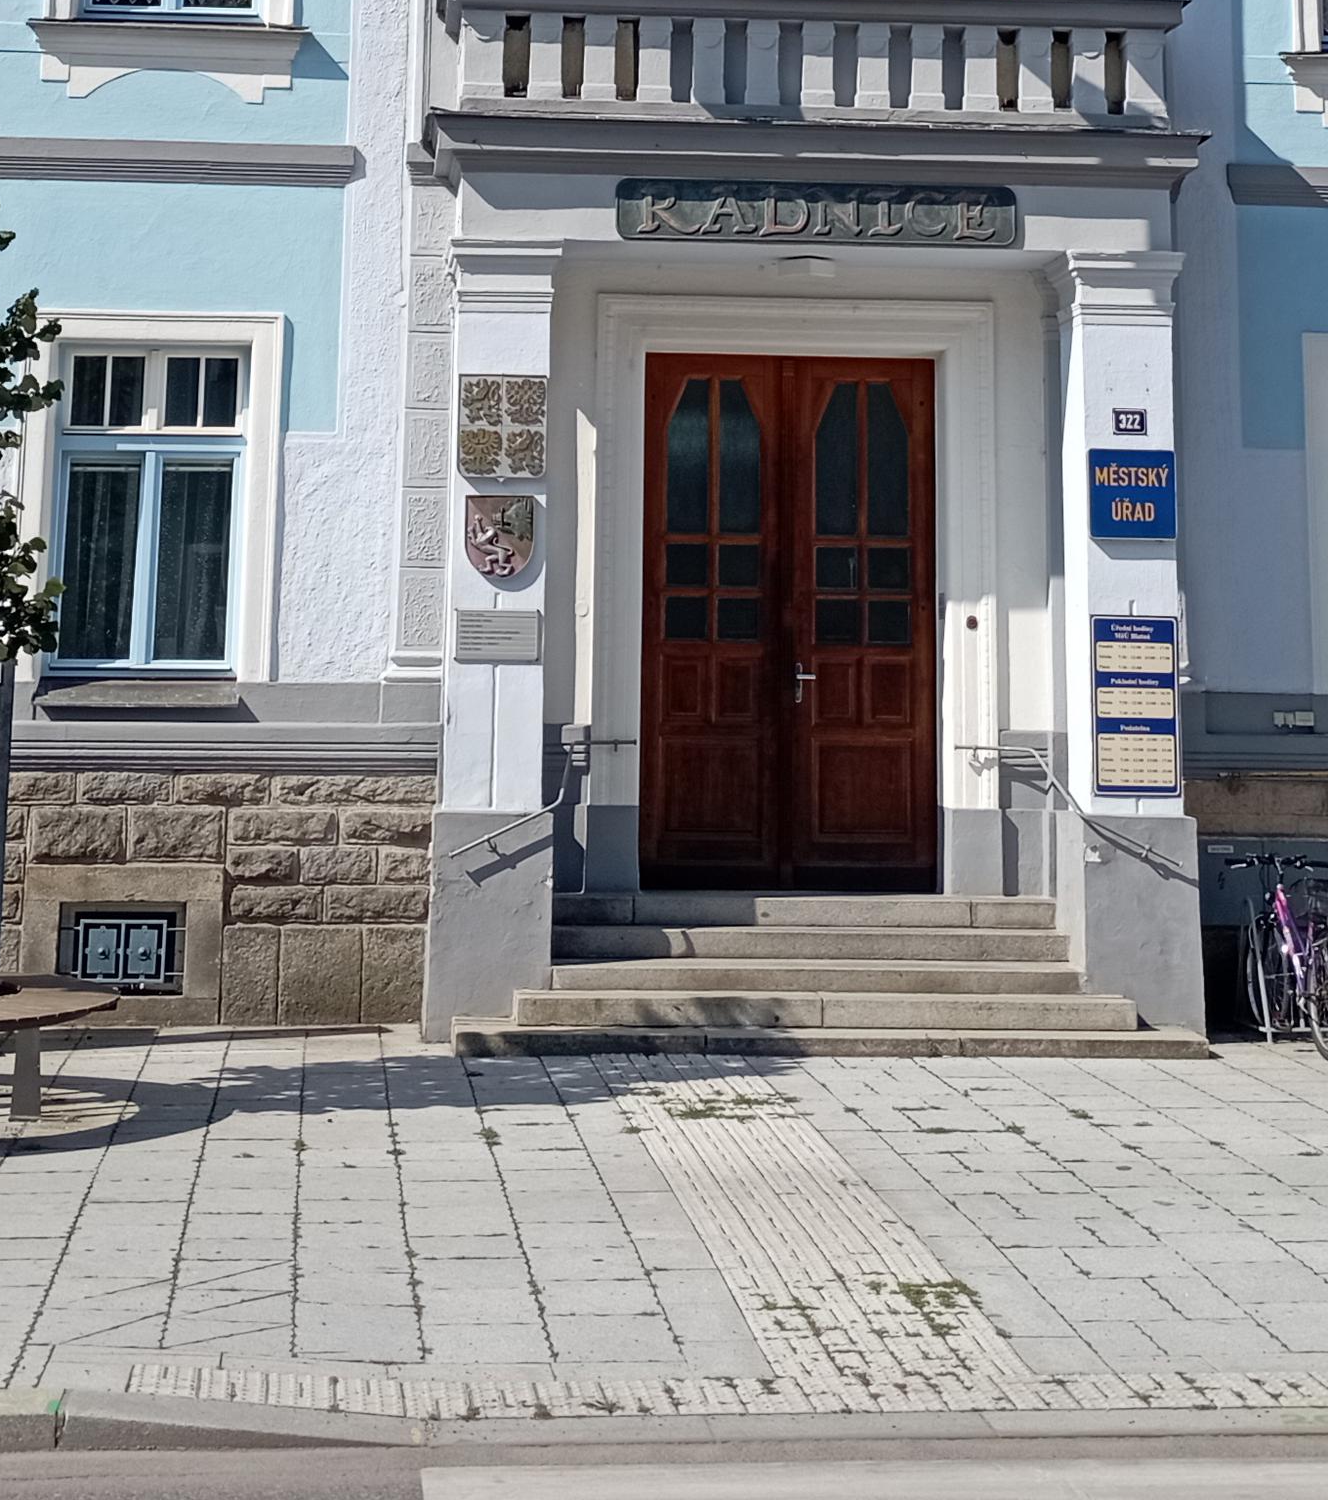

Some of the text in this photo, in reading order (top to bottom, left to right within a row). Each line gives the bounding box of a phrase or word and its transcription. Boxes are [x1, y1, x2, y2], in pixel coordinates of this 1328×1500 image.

[635, 185, 996, 241] RADNICE
[1119, 414, 1141, 430] 322
[1095, 463, 1169, 488] MĚSTSKÝ
[1111, 497, 1155, 522] ÚŘAD
